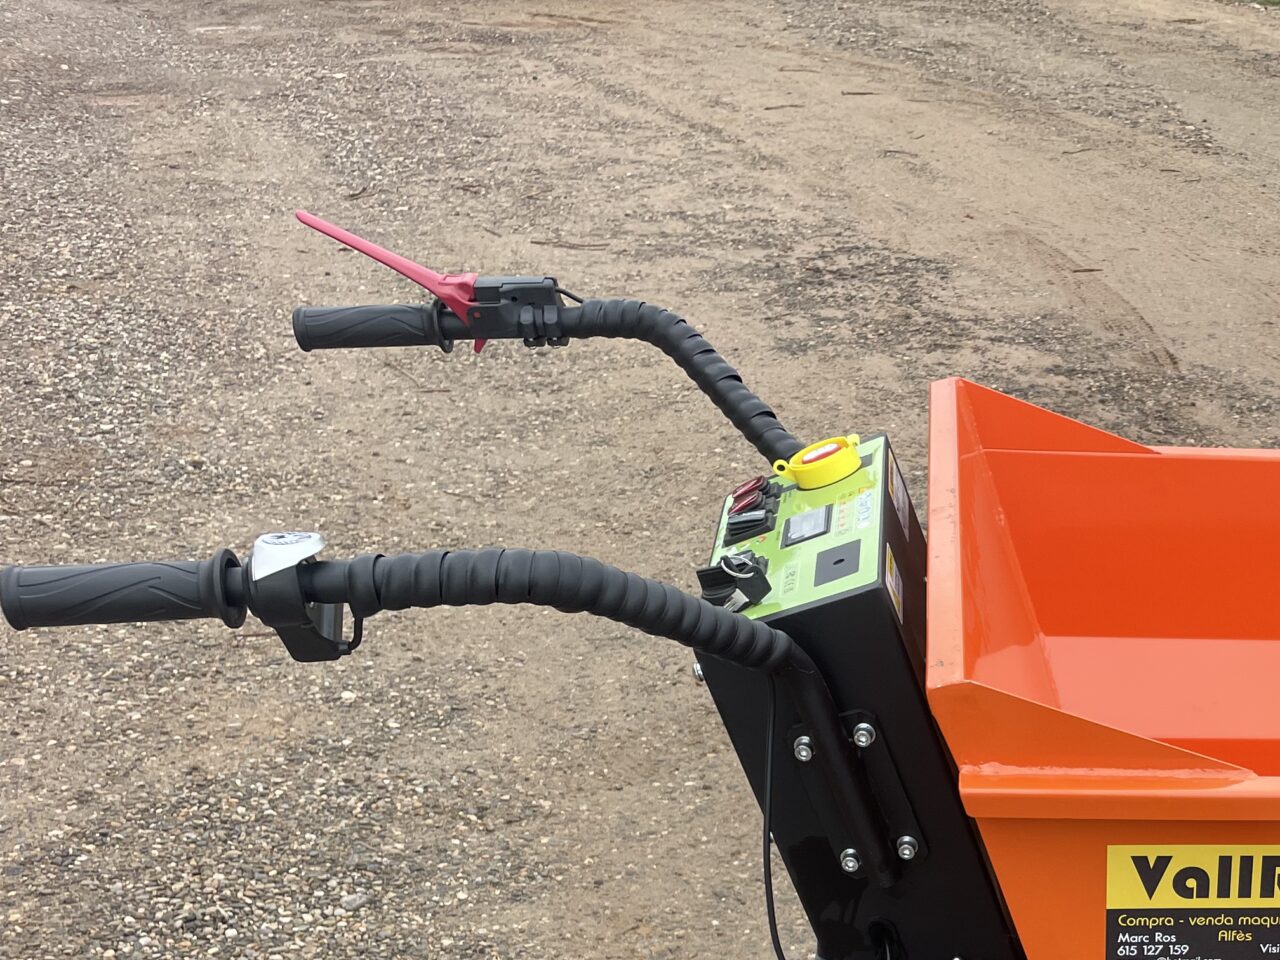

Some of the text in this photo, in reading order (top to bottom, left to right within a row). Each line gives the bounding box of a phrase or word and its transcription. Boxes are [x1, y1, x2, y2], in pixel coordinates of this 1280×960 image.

[1117, 914, 1174, 929] Compra
[1189, 913, 1233, 926] venda
[1117, 932, 1176, 943] Marc Ros
[1217, 930, 1252, 942] Alfès
[1117, 944, 1189, 956] 615 127 159
